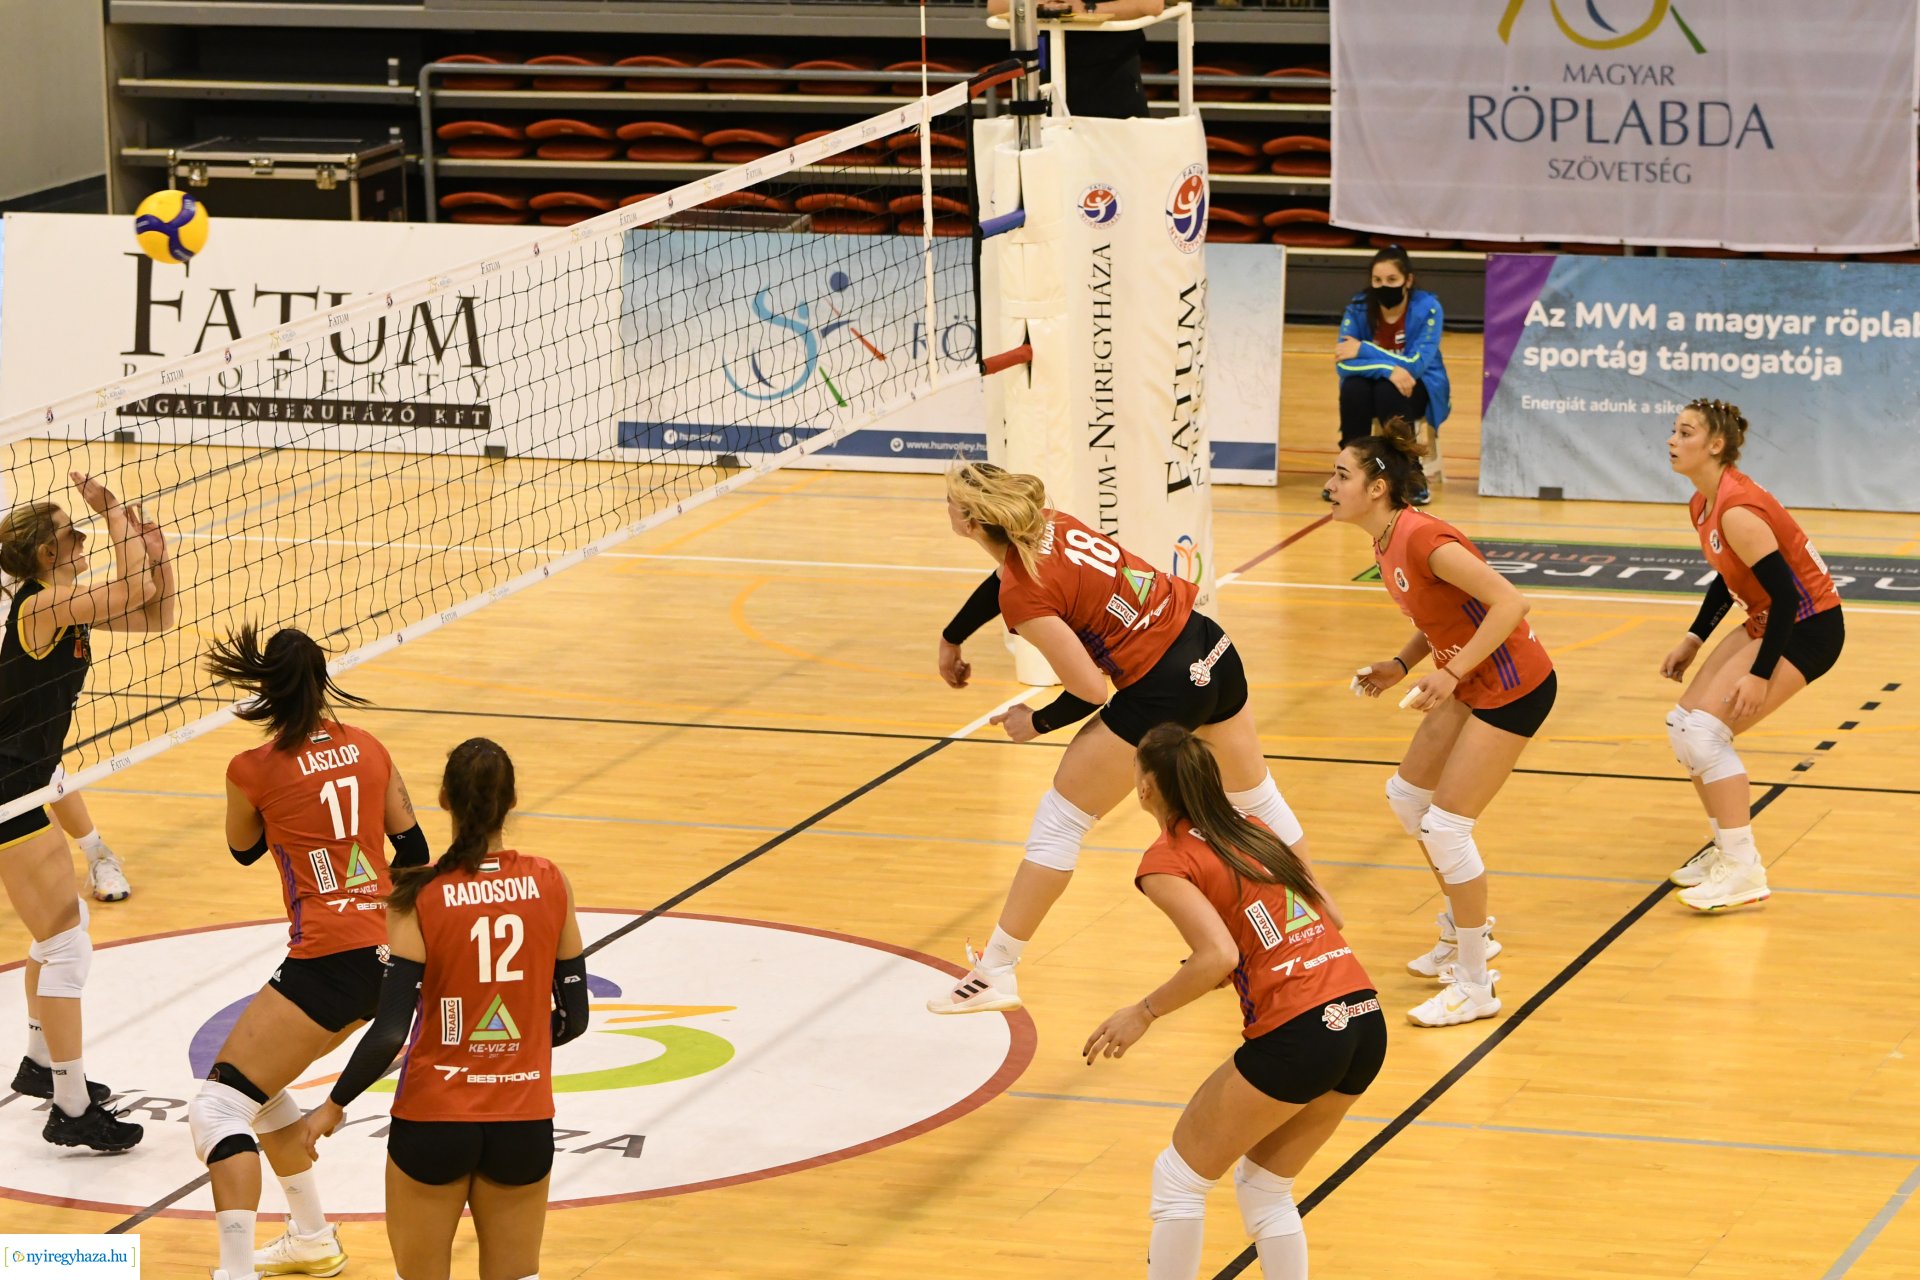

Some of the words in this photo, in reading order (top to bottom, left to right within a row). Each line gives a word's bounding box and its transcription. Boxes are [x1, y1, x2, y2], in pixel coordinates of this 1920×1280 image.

[1562, 62, 1676, 87] MAGYAR
[1468, 84, 1775, 150] RÖPLABDA
[1547, 155, 1693, 185] SZÖVETSÉG
[120, 252, 489, 369] FATUM
[328, 312, 350, 328] FATUM
[1523, 301, 1566, 329] Az
[1575, 301, 1657, 330] MVM
[1666, 309, 1685, 332] a
[1695, 310, 1816, 341] magyar
[160, 368, 185, 385] FATUM
[1523, 340, 1648, 376] sportág
[1657, 342, 1843, 382] támogatója
[122, 362, 490, 399] POPERTY
[1165, 281, 1199, 502] FATUM
[434, 408, 486, 426] KFT
[1521, 394, 1587, 414] Energiát
[1590, 397, 1637, 414] adunk
[1640, 402, 1650, 414] a
[1065, 528, 1121, 578] 18
[110, 756, 132, 772] FATUM
[297, 744, 361, 776] LÁSZLOP
[319, 775, 360, 840] 17
[313, 851, 332, 891] STRABAG
[442, 875, 541, 908] RADOSOVA
[1250, 905, 1278, 945] STRABAG
[1288, 927, 1316, 945] KE-VIZ
[1314, 923, 1326, 936] 21
[469, 913, 525, 984] 12
[448, 999, 457, 1043] STRABAG
[468, 1043, 507, 1054] KE-VIZ
[507, 1042, 521, 1052] 21
[466, 1070, 541, 1084] BESTRONG
